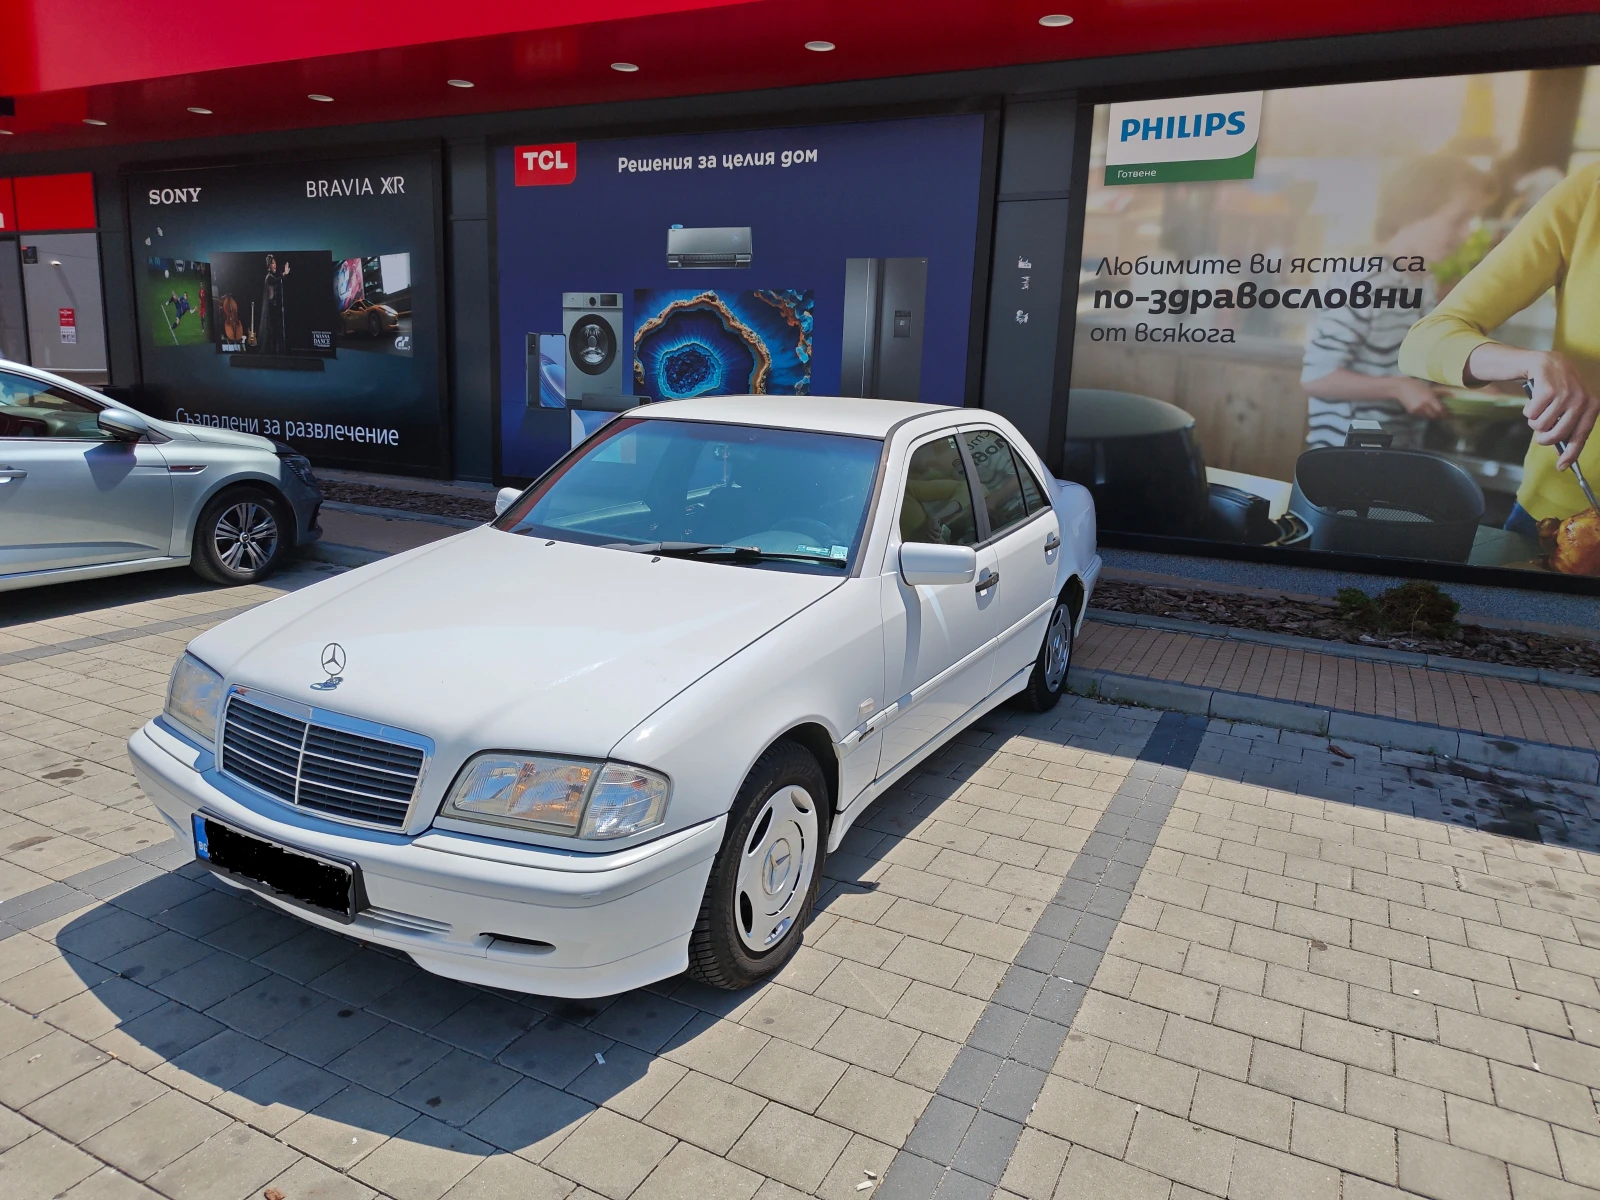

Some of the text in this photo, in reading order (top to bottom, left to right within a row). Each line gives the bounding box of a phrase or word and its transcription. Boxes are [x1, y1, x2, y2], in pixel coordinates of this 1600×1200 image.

[1119, 109, 1247, 143] PHILIPS
[522, 150, 569, 171] TCL
[617, 148, 819, 174] Решения за целия дом
[306, 175, 406, 198] BRAVIA XR
[1116, 169, 1158, 180] Готвене
[148, 187, 202, 206] SONY
[1094, 252, 1428, 277] Любимите ви ястия са
[1092, 280, 1424, 316] по-здравословни
[1088, 321, 1237, 345] от всякога
[262, 418, 281, 436] за
[285, 419, 400, 447] развлечение
[197, 840, 208, 853] BG
